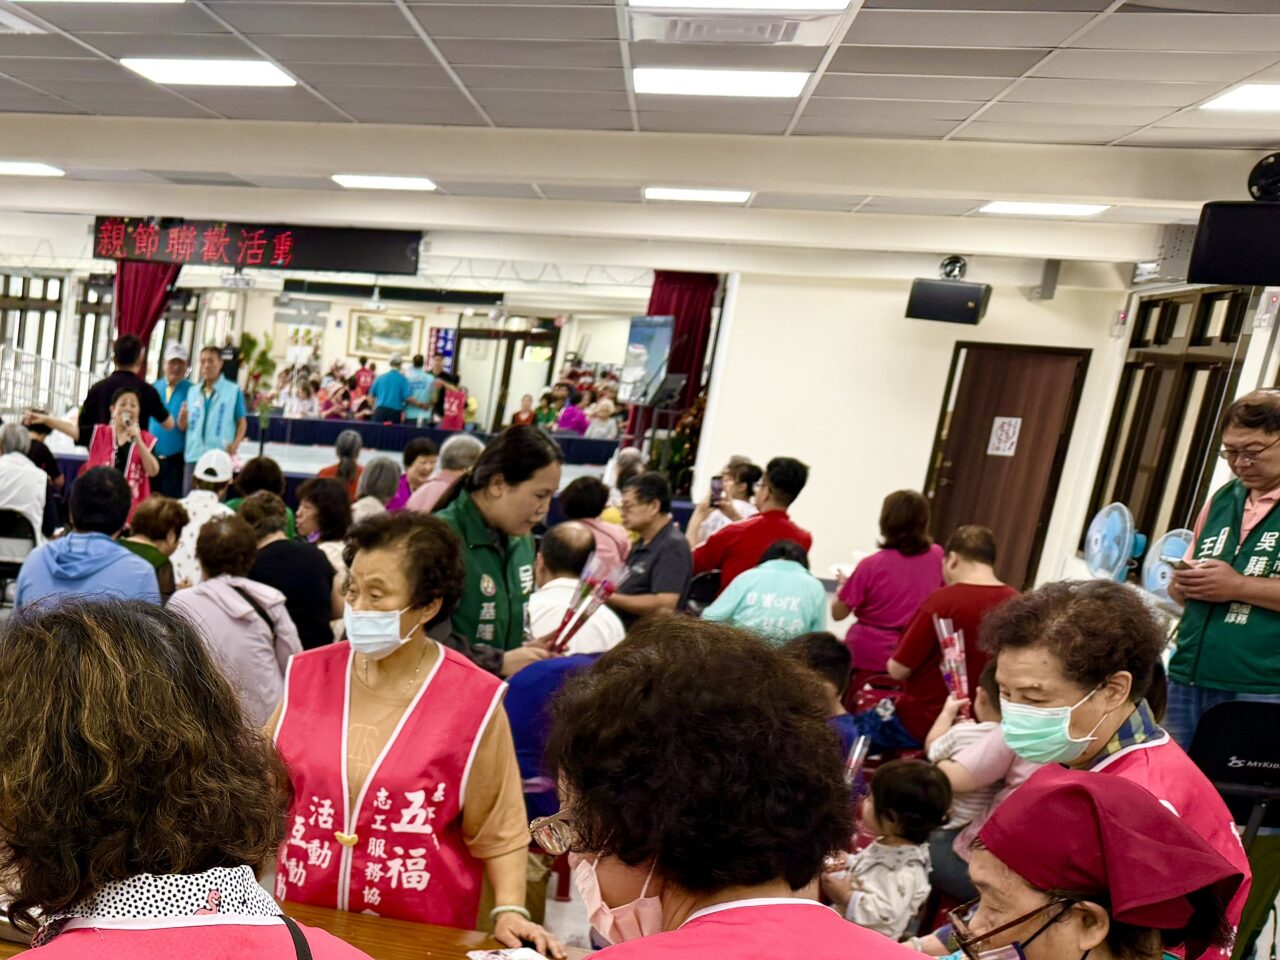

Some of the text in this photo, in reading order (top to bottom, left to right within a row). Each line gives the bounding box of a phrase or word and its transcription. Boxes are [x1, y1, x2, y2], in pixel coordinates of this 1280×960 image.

[308, 796, 335, 869] 活動
[361, 787, 393, 917] 志工服務協
[386, 789, 433, 891] 五福
